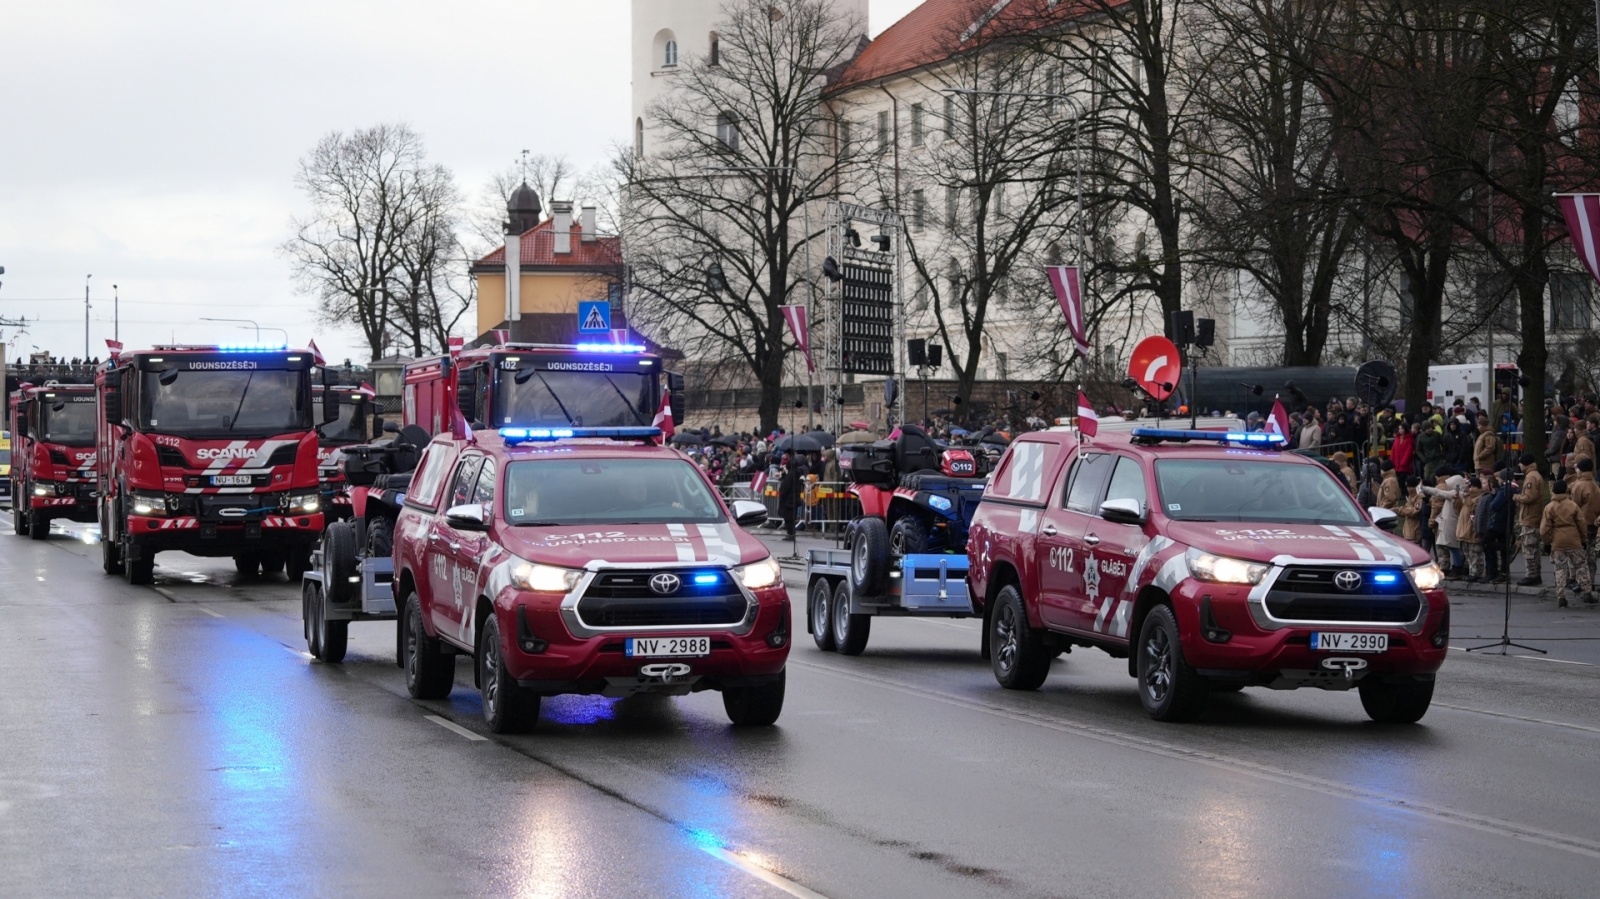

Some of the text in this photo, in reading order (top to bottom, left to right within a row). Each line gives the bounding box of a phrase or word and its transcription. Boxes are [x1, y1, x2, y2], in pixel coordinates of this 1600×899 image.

[189, 361, 257, 370] UGUNSDZĒSĒJI
[500, 361, 516, 370] 102
[547, 362, 613, 371] UGUNSDZĒSĒJI
[164, 437, 180, 447] 112
[196, 448, 258, 459] SCANIA
[959, 463, 973, 471] 112
[570, 531, 627, 540] 112
[1056, 546, 1074, 573] 112
[437, 553, 447, 580] 112
[1101, 558, 1127, 577] GLĀBĒJI
[637, 639, 707, 654] NV-2988
[1321, 634, 1386, 649] NV-2990
